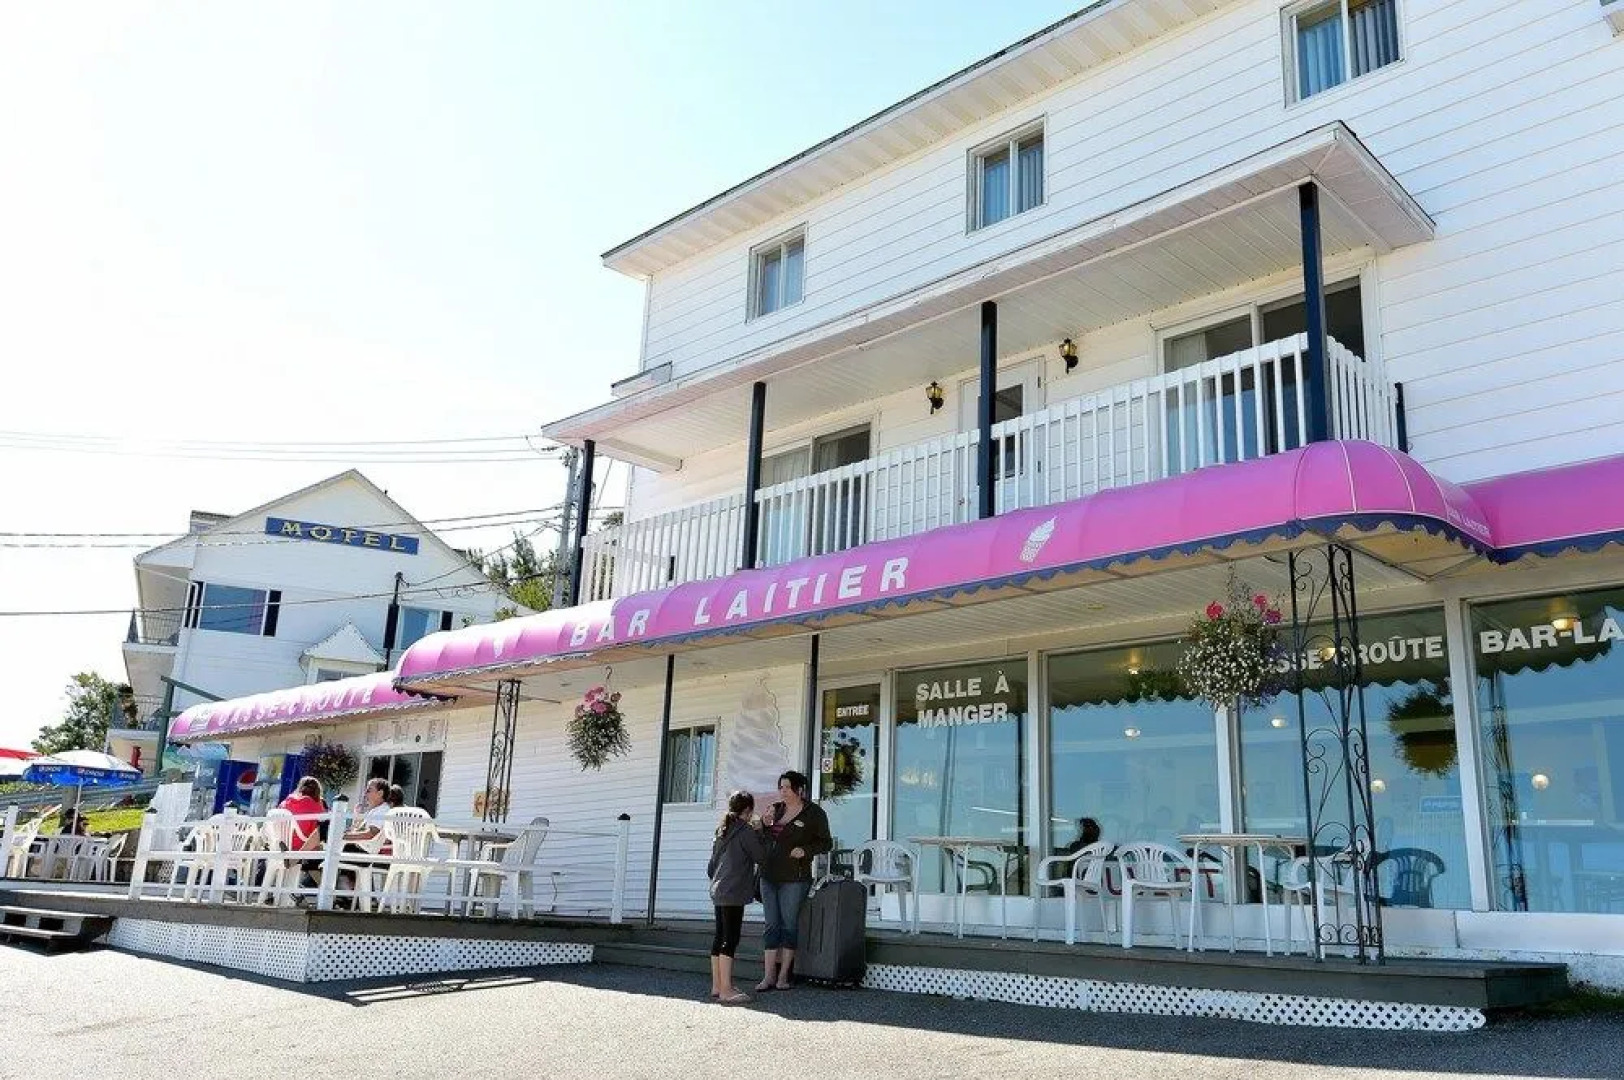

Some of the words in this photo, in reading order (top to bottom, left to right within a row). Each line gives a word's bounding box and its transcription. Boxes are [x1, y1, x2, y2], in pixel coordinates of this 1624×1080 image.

[280, 520, 406, 550] MOTEL
[569, 608, 651, 647] BAR
[693, 556, 909, 627] LAITIER
[916, 677, 982, 702] SALLE
[994, 670, 1010, 695] À
[917, 702, 1008, 729] MANGER
